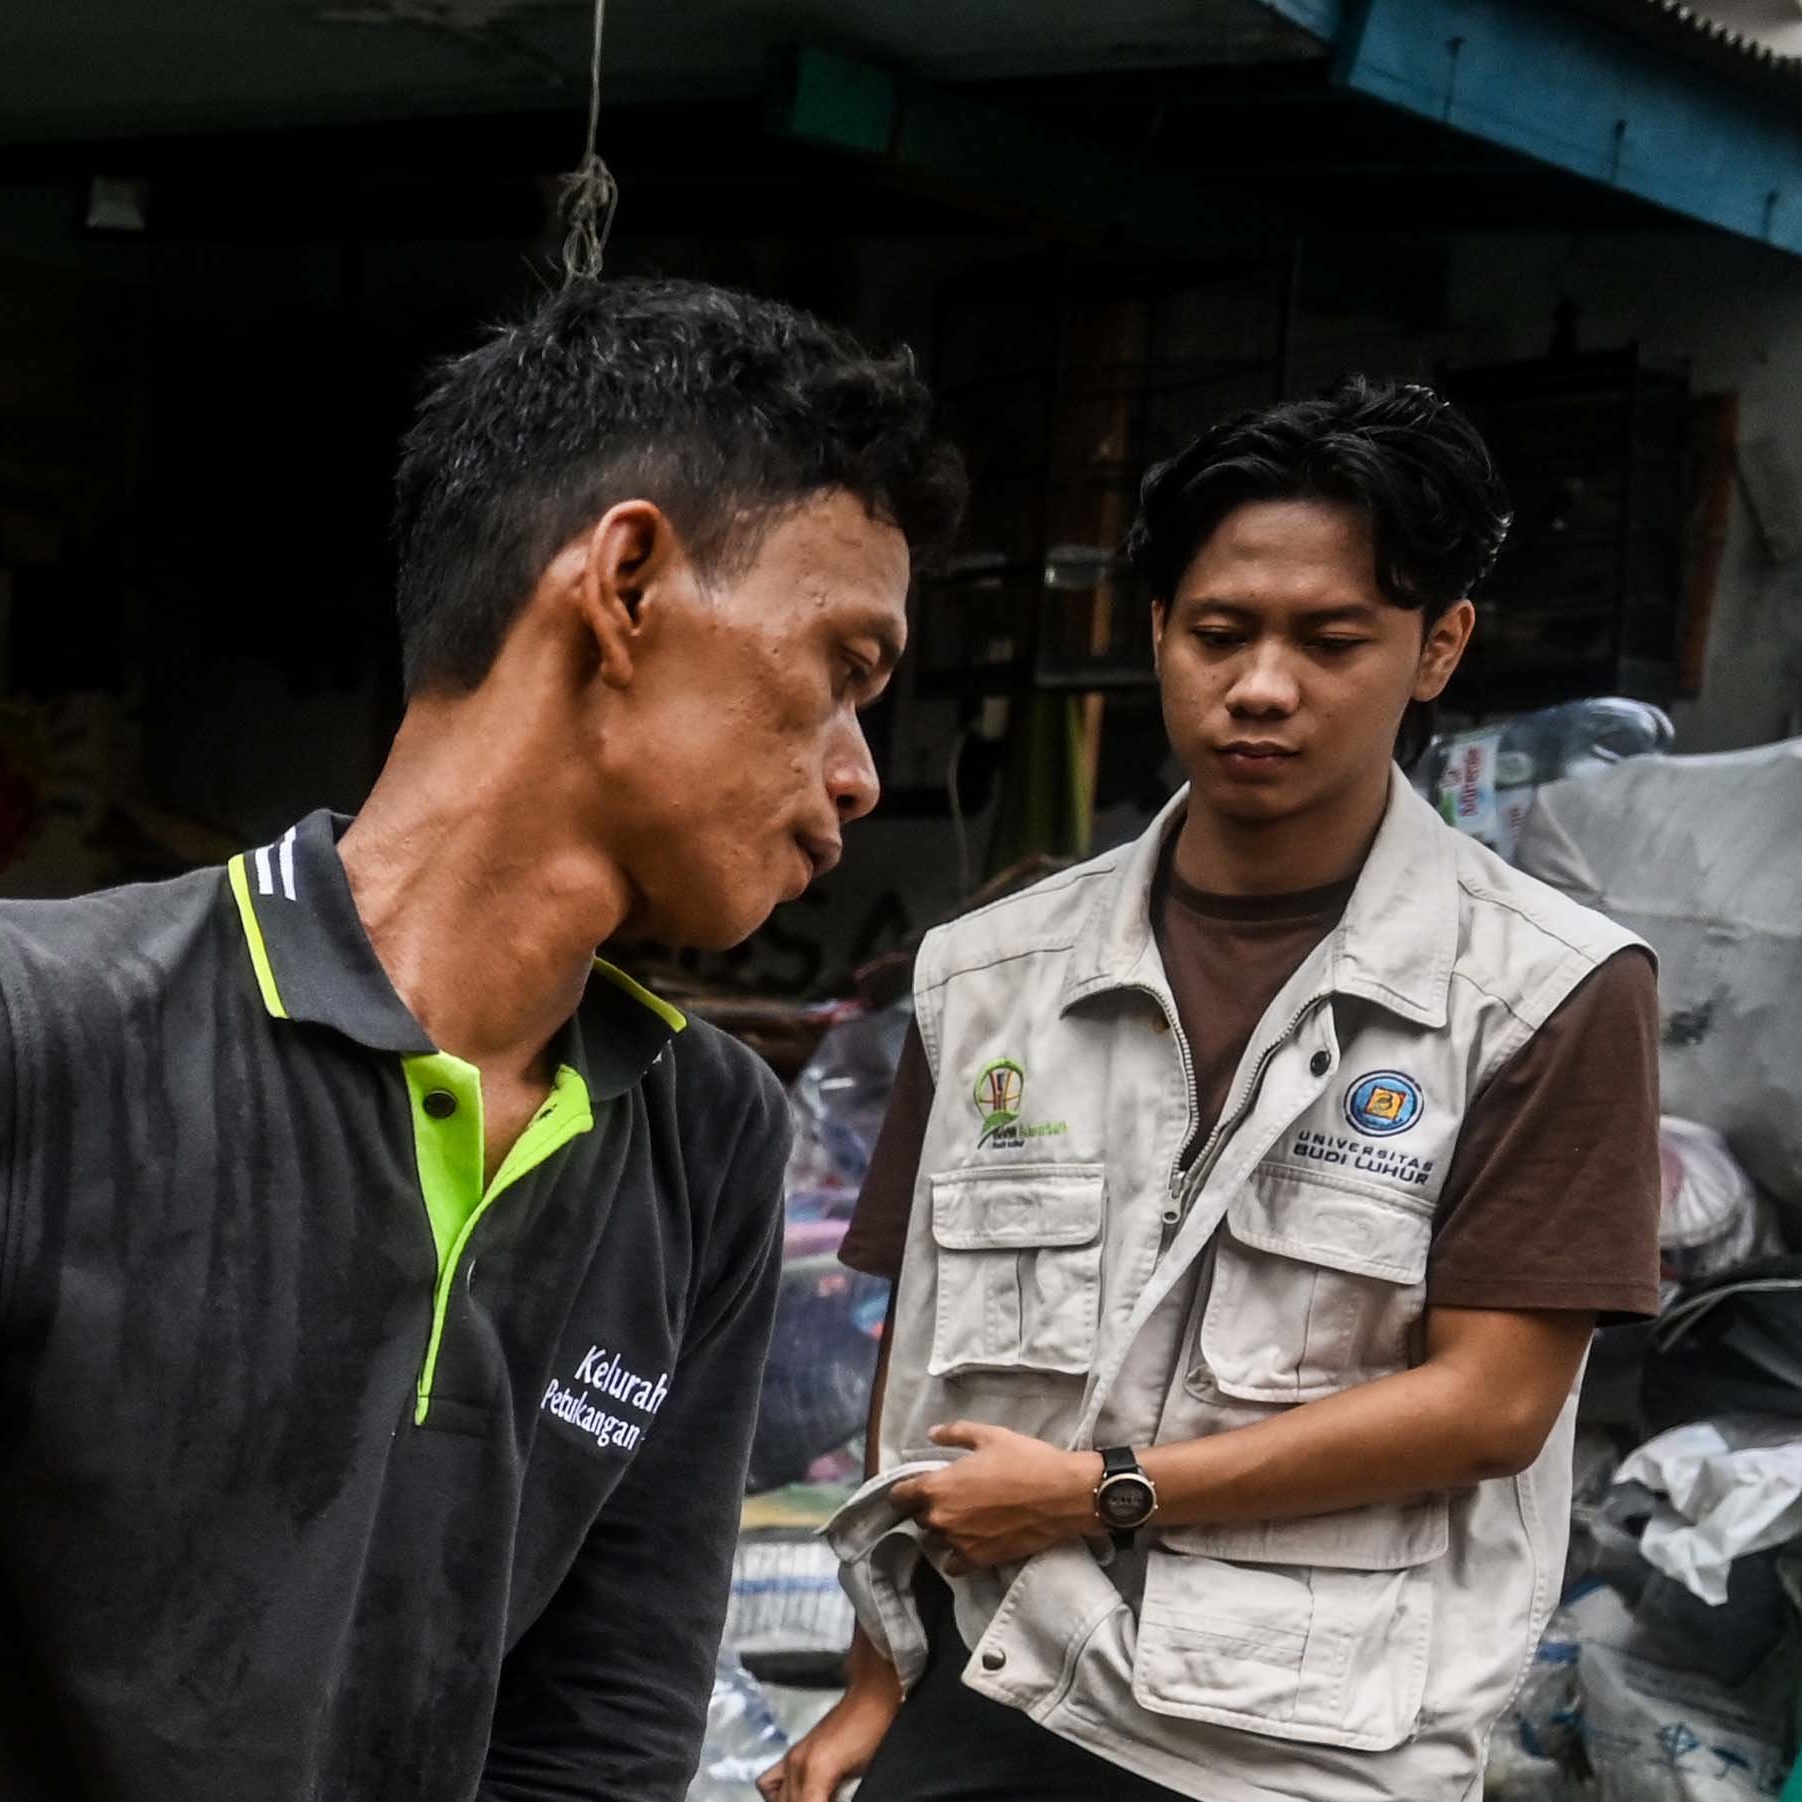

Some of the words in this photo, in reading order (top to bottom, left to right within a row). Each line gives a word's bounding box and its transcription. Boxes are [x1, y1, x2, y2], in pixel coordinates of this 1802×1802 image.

[1293, 1142, 1347, 1165] BUDI
[1354, 1156, 1431, 1185] LUHUR
[1298, 1130, 1433, 1172] UNIVERSITAS
